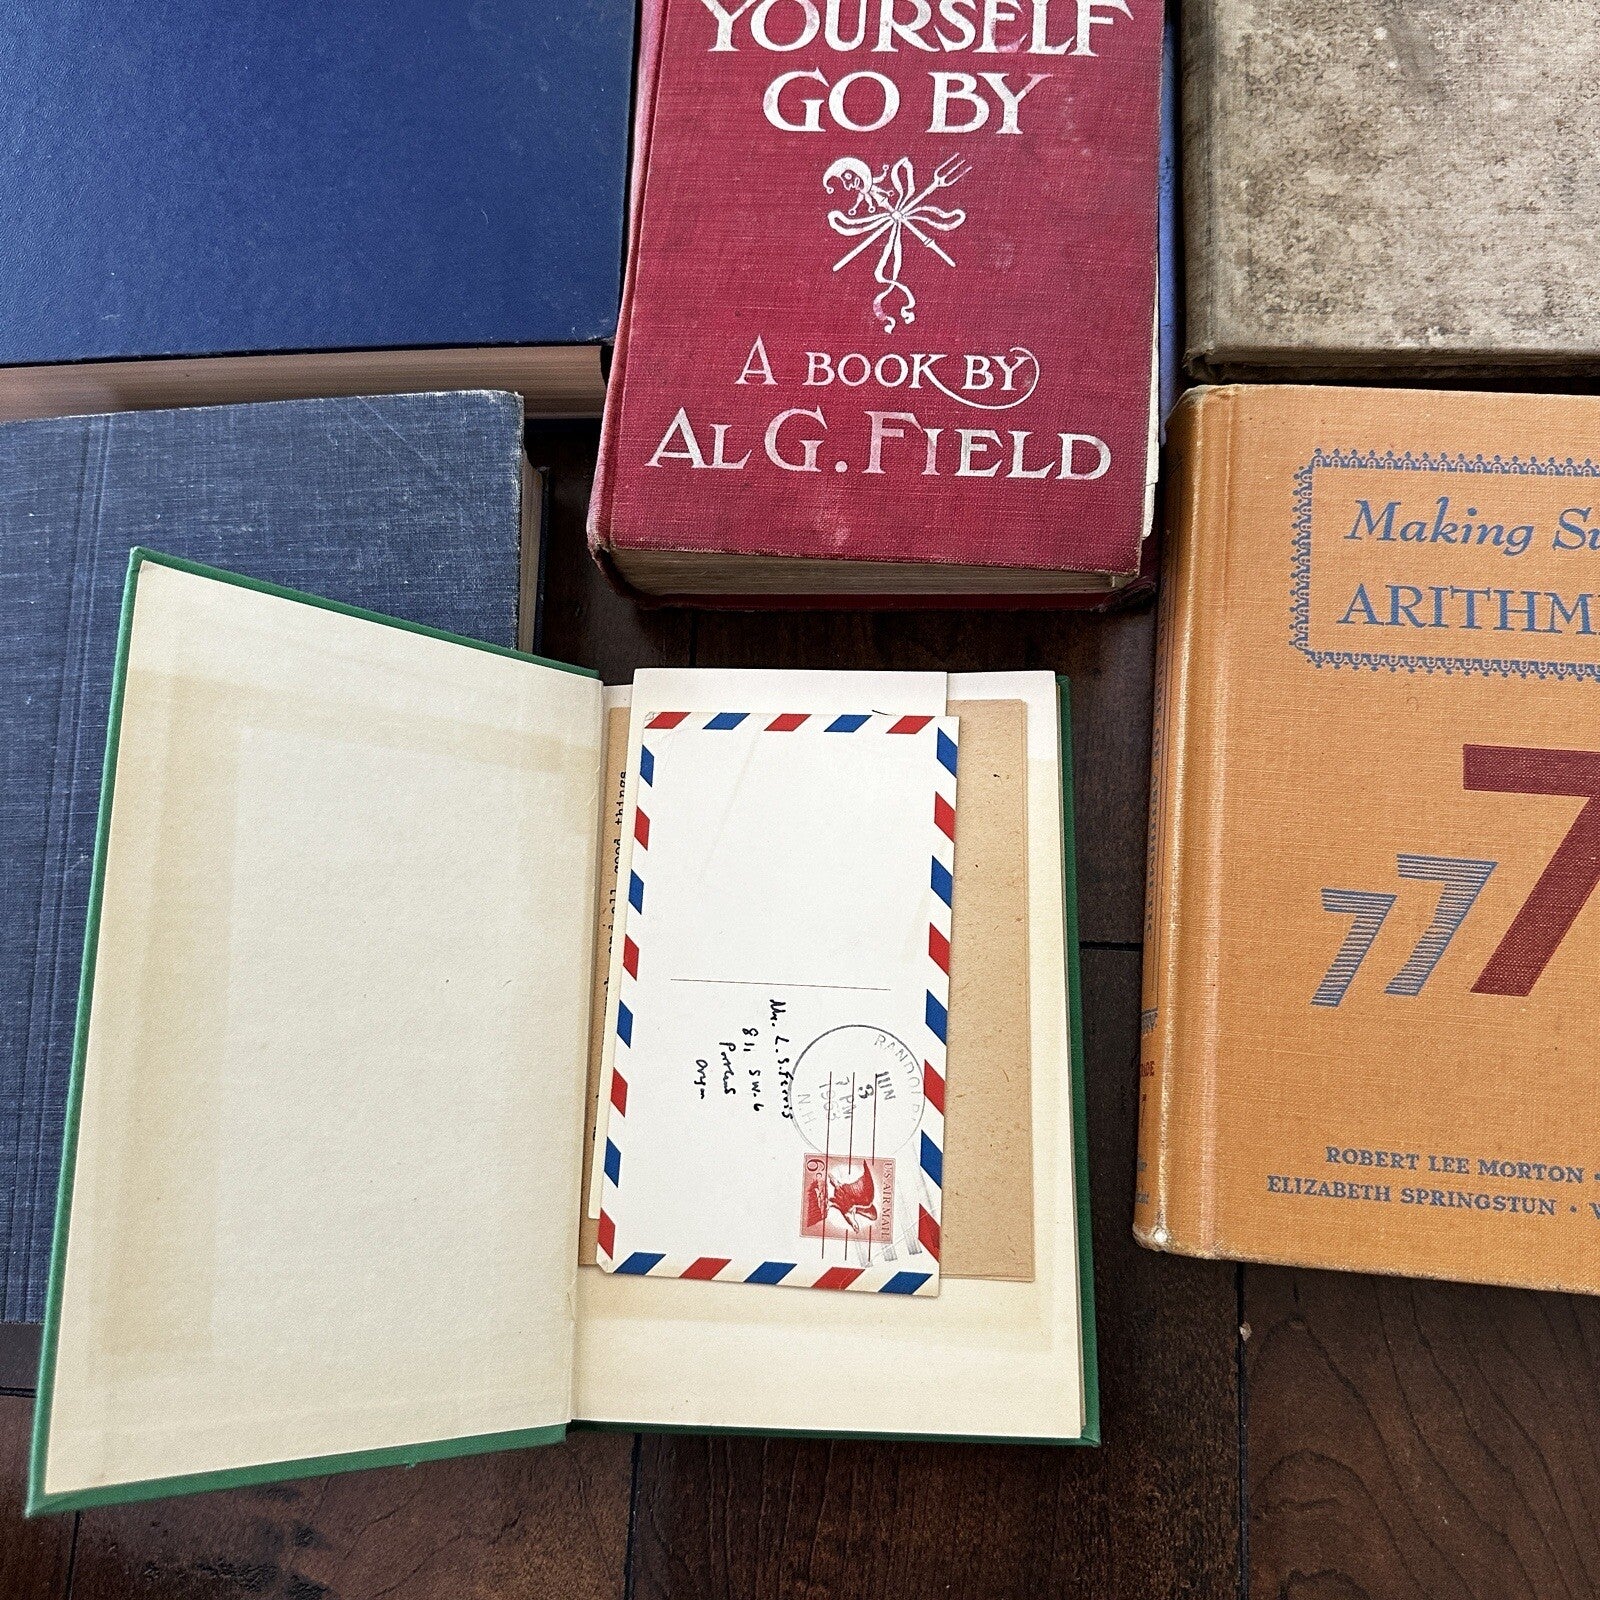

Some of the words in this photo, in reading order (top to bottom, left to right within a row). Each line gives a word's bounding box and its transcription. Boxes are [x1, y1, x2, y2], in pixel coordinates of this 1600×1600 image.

[707, 0, 1134, 56] YOURSELF
[762, 67, 899, 133] GO
[926, 71, 1054, 135] BY
[735, 335, 779, 386] A
[802, 351, 948, 393] BOOK
[961, 348, 1034, 392] BY
[644, 407, 751, 470] AL
[764, 405, 847, 473] G.
[863, 411, 1112, 481] FIELD
[1344, 496, 1534, 556] Making
[1337, 583, 1600, 636] ARITHM
[614, 771, 626, 826] things
[858, 1084, 874, 1100] 3
[1326, 1146, 1420, 1171] ROBERT
[1428, 1155, 1470, 1175] LEE
[1477, 1158, 1584, 1184] MORTON
[882, 1182, 892, 1204] AIR
[1267, 1175, 1391, 1203] ELIZABETH
[1401, 1187, 1557, 1216] SPRINGSTUN
[881, 1207, 891, 1239] MAIL
